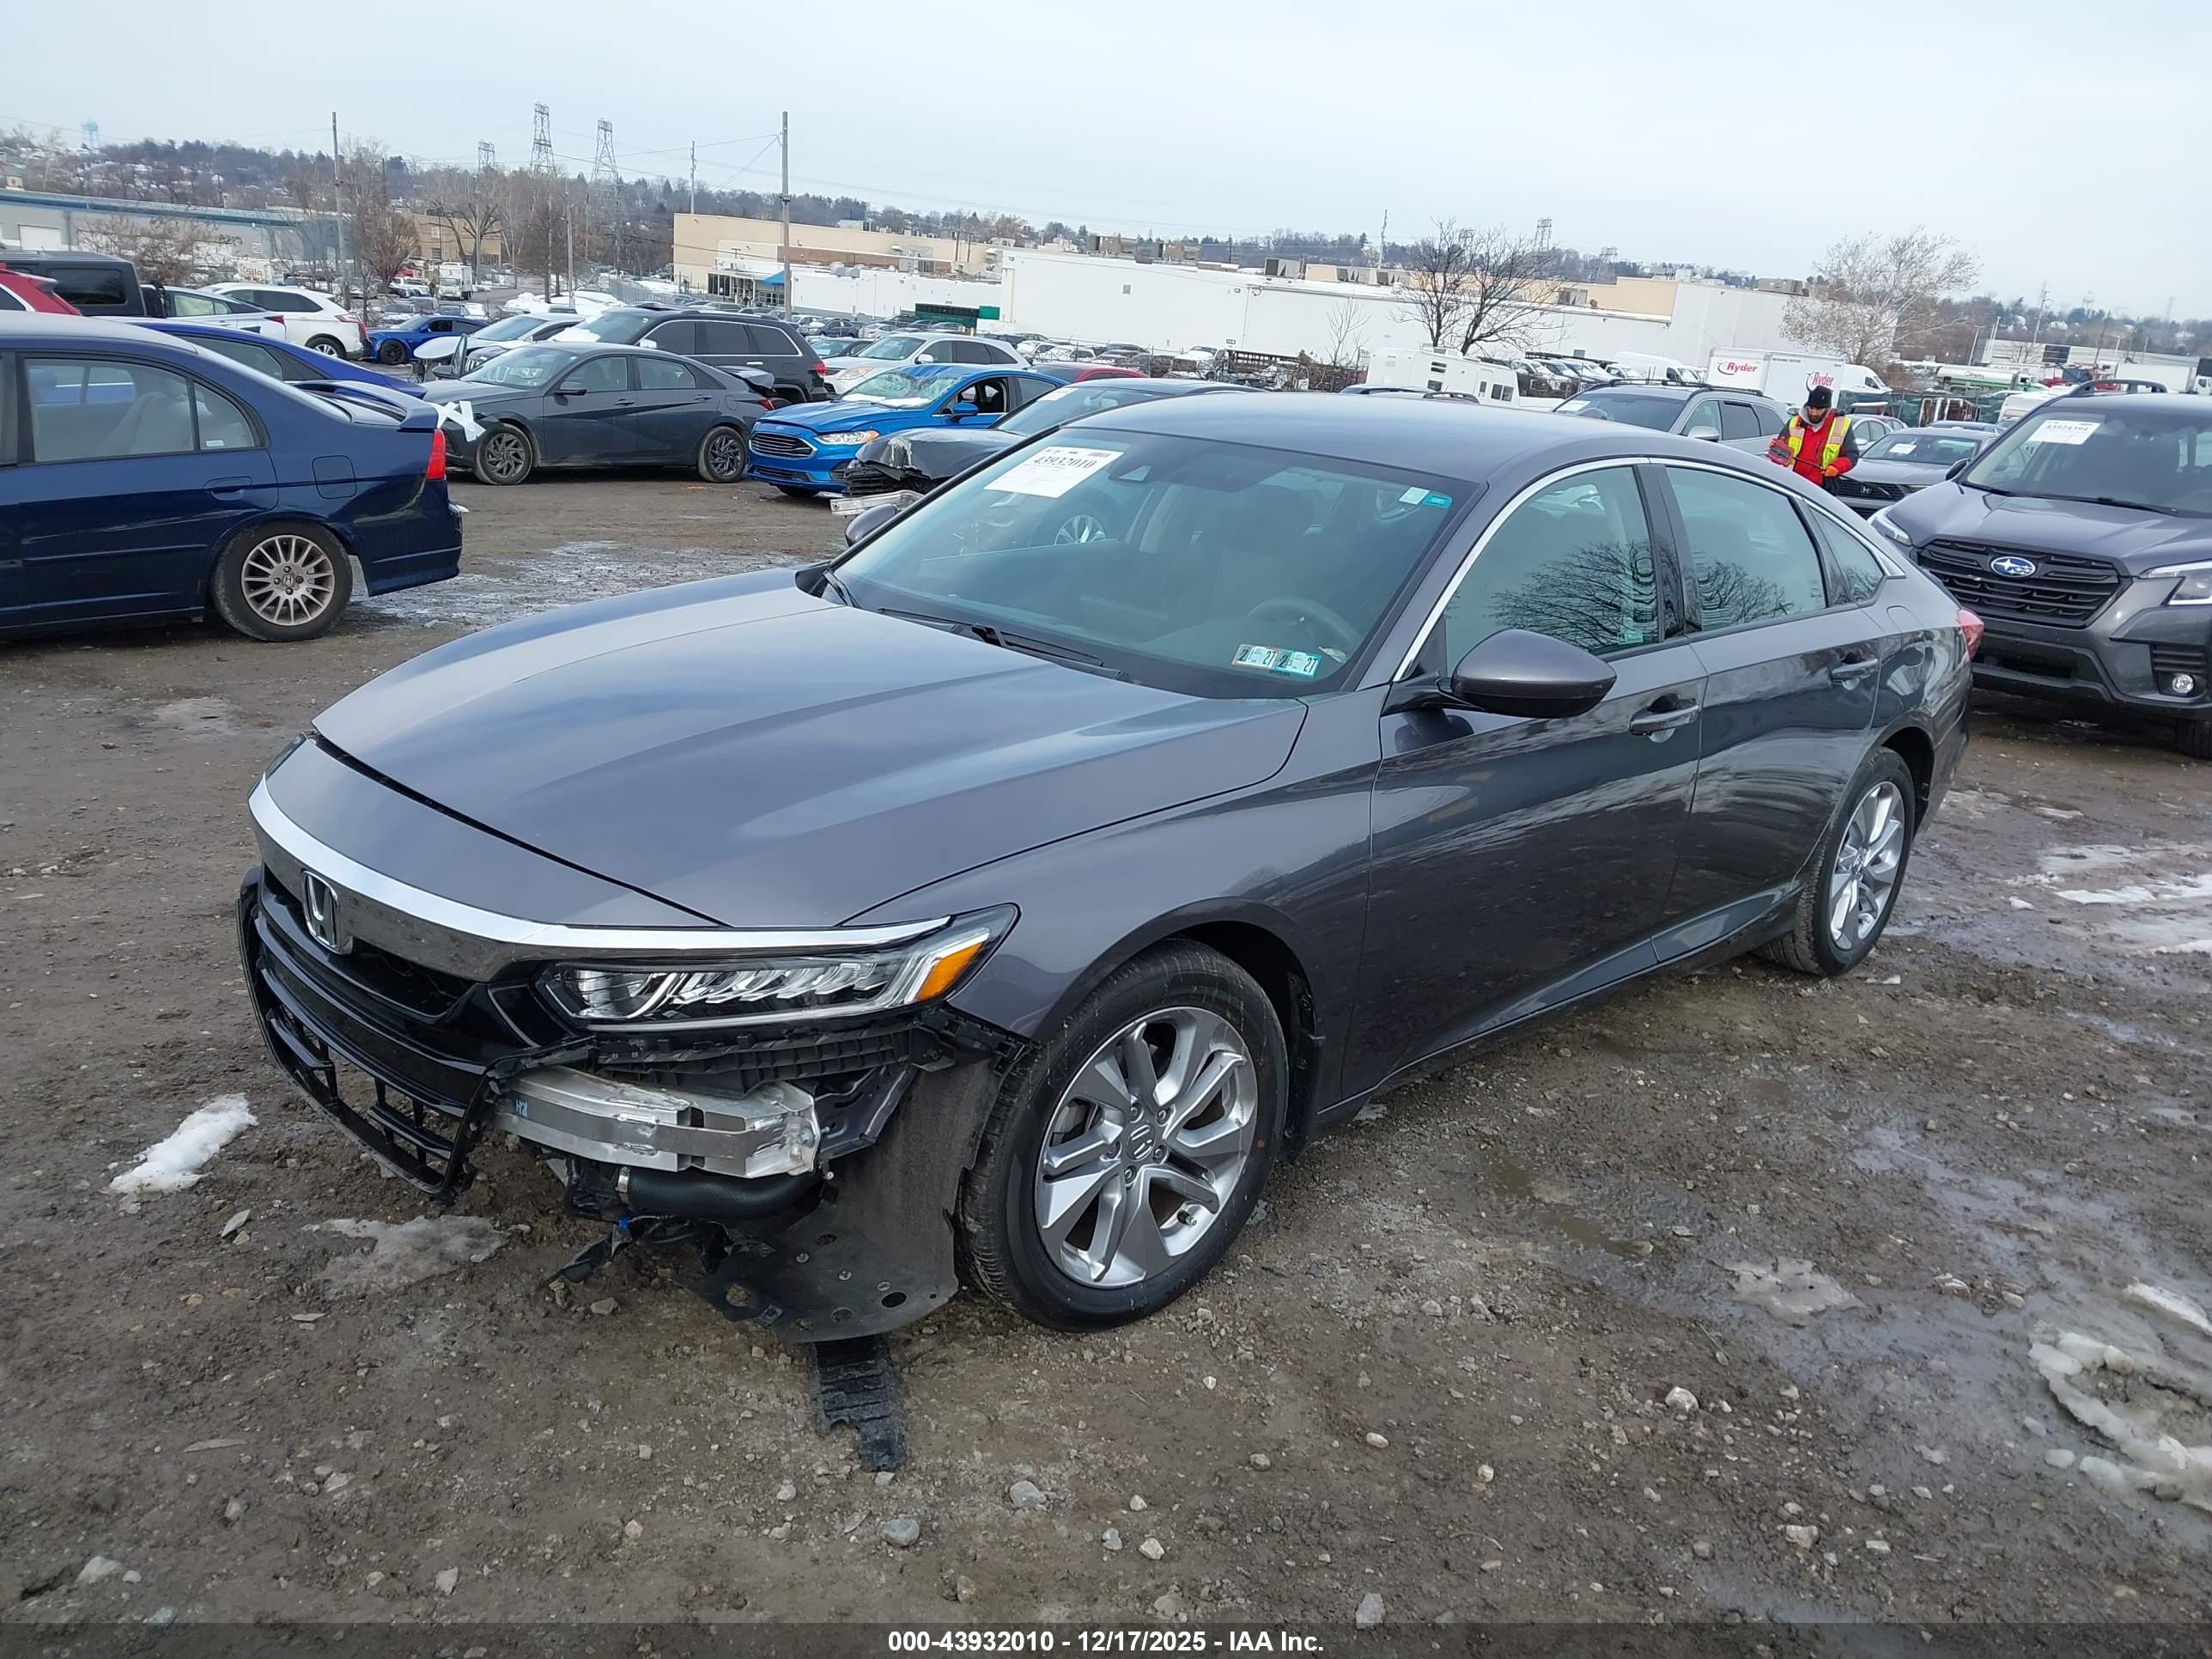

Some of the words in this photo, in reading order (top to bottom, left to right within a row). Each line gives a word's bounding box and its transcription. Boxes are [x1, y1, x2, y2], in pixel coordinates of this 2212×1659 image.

[1726, 362, 1759, 373] Ryder
[1812, 371, 1834, 386] Ryder
[1033, 455, 1097, 469] 43932010
